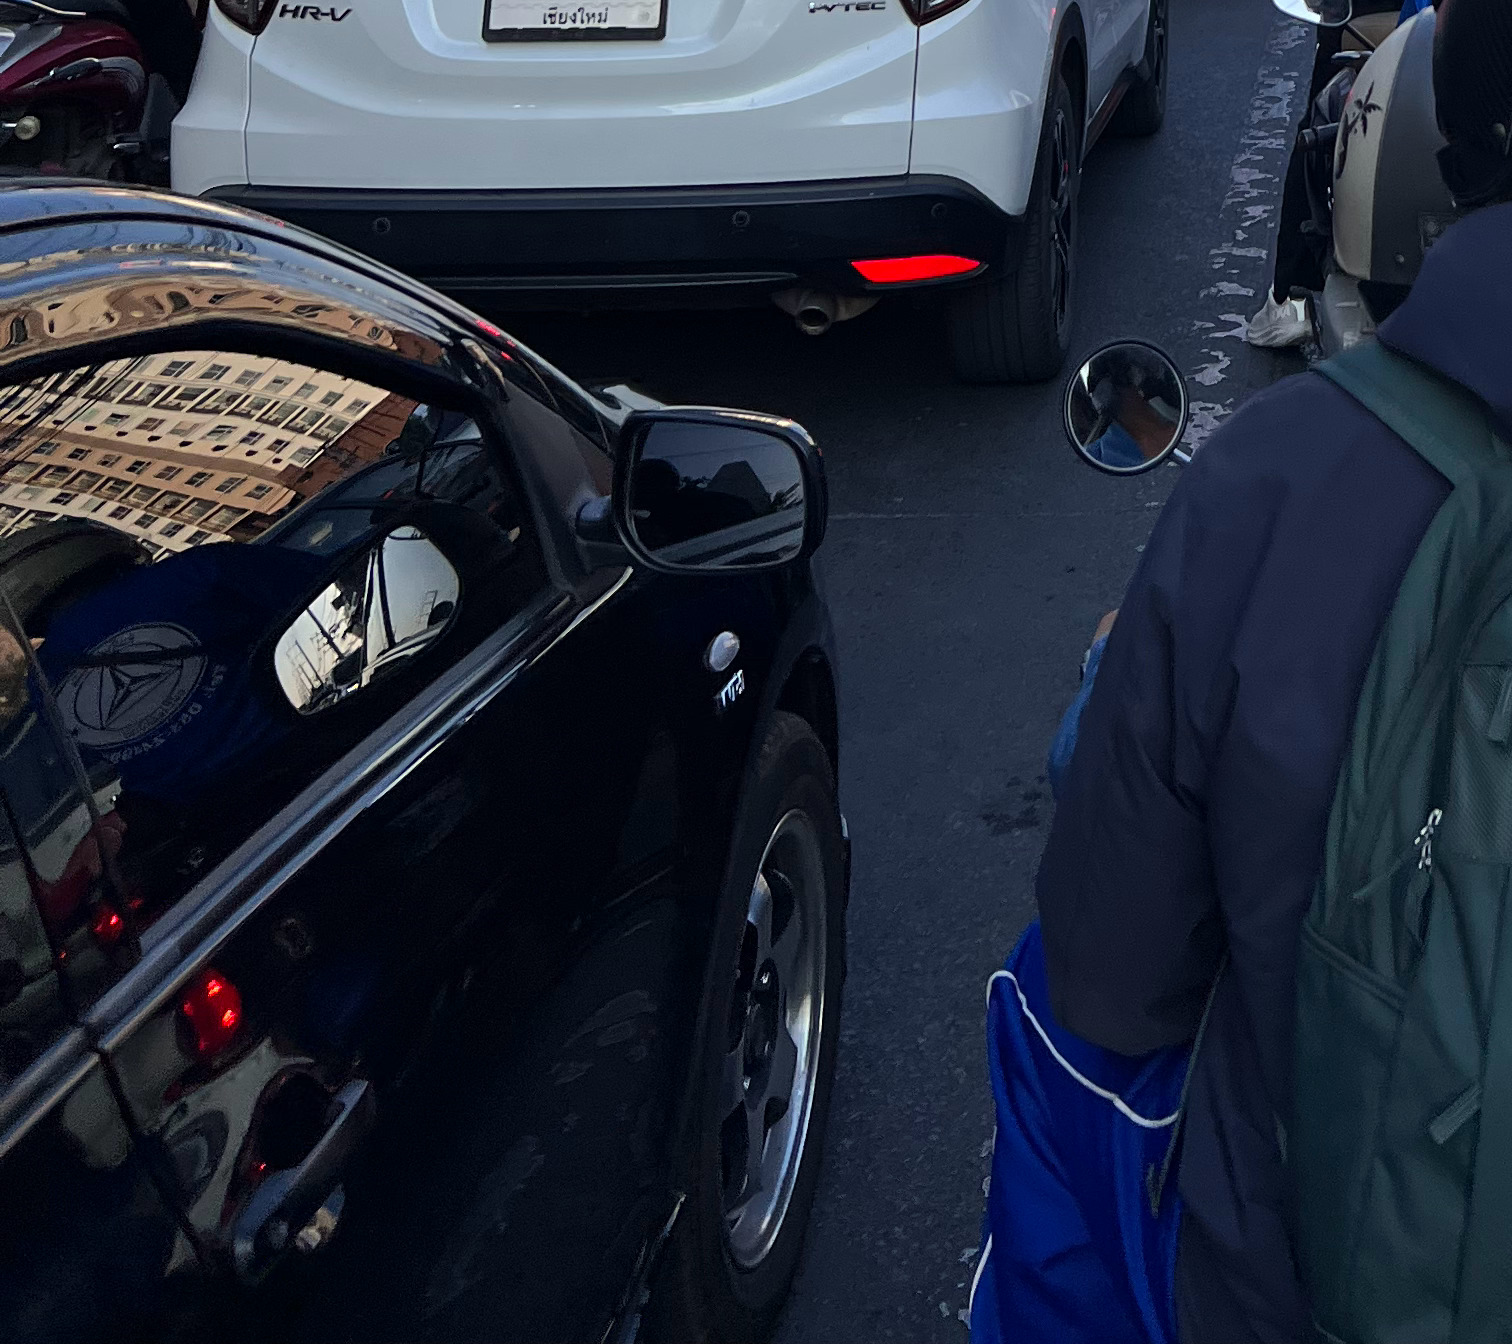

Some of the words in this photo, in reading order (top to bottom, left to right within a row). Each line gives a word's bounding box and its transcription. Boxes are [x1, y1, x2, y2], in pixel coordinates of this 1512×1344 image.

[279, 4, 353, 21] HR-V
[543, 7, 609, 25] เชียงใหม่
